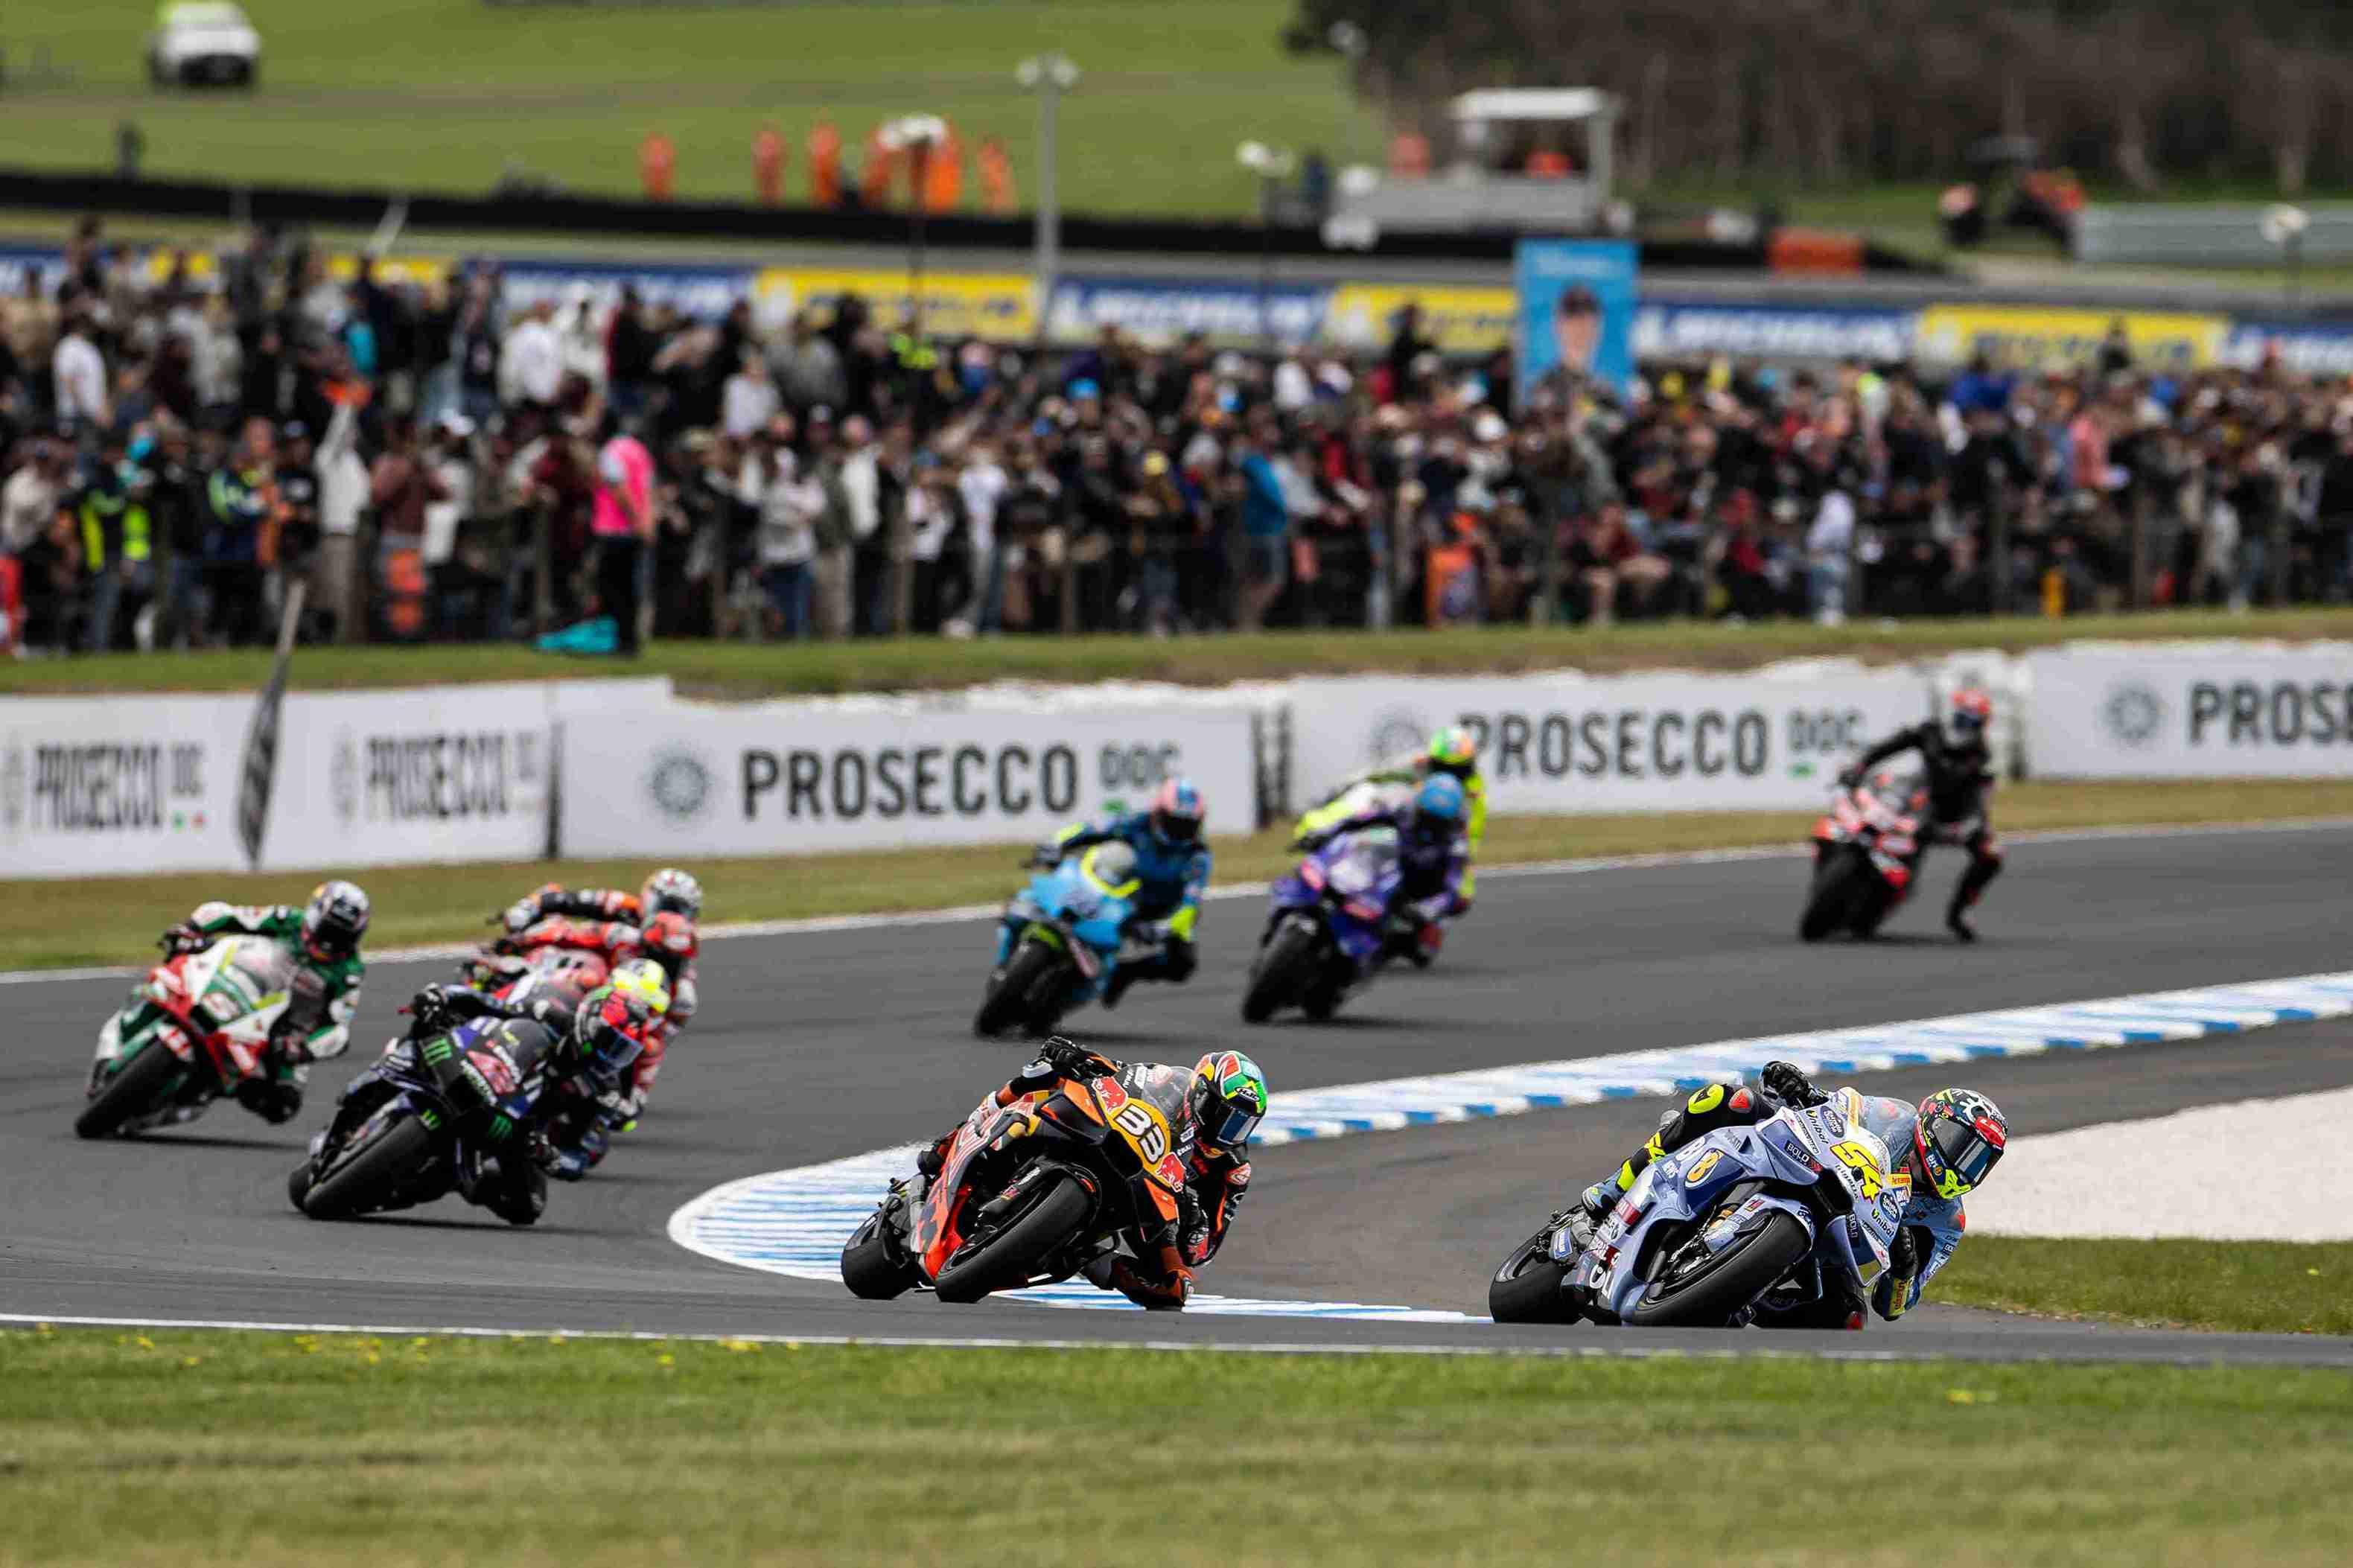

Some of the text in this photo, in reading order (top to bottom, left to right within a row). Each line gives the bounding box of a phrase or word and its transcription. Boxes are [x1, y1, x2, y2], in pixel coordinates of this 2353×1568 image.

[1457, 709, 1768, 778] PROSECCO
[742, 743, 1078, 819] PROSECCO
[1113, 1103, 1169, 1164] 33
[1786, 1142, 1811, 1163] BOLD
[1830, 1141, 1884, 1204] 54
[1849, 1214, 1859, 1238] BOLD
